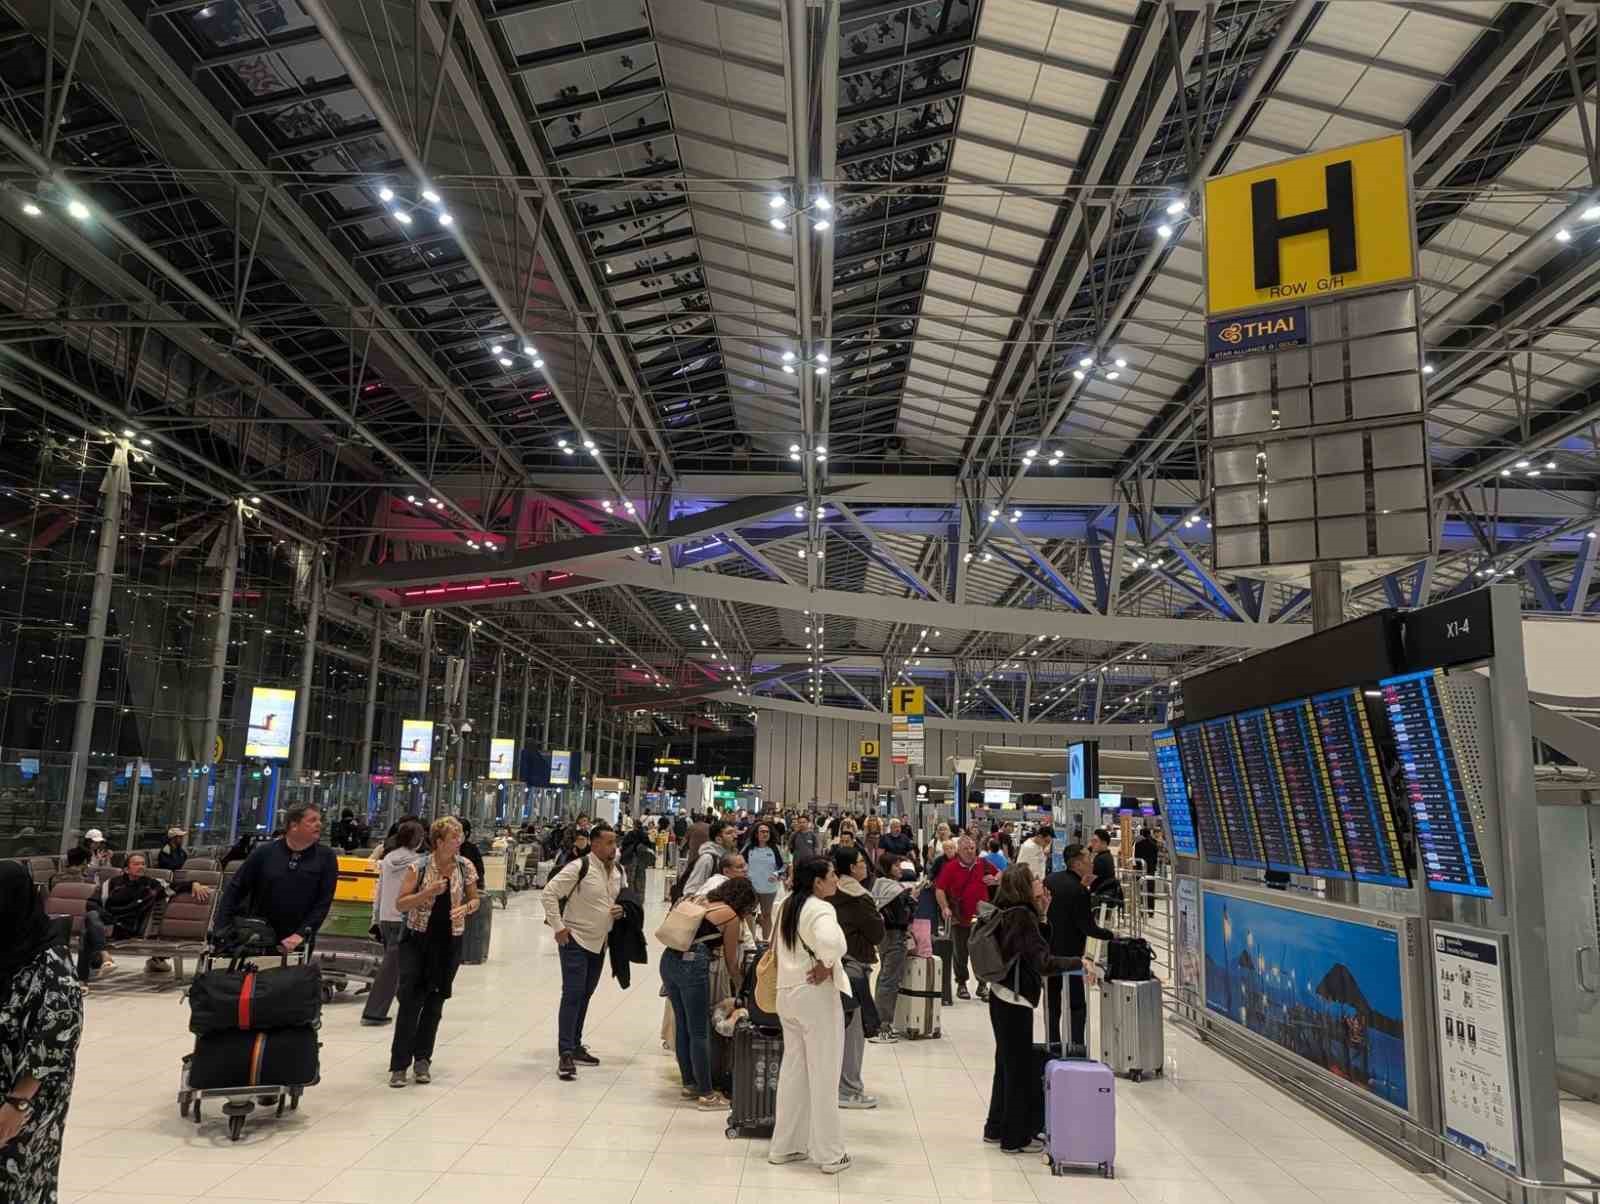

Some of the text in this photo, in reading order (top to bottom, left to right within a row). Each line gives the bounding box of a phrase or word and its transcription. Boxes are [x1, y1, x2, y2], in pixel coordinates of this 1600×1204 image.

[1251, 160, 1357, 290] H
[1270, 276, 1344, 298] ROW G/H
[1244, 316, 1295, 338] THAI
[901, 690, 914, 711] F
[864, 742, 875, 755] D
